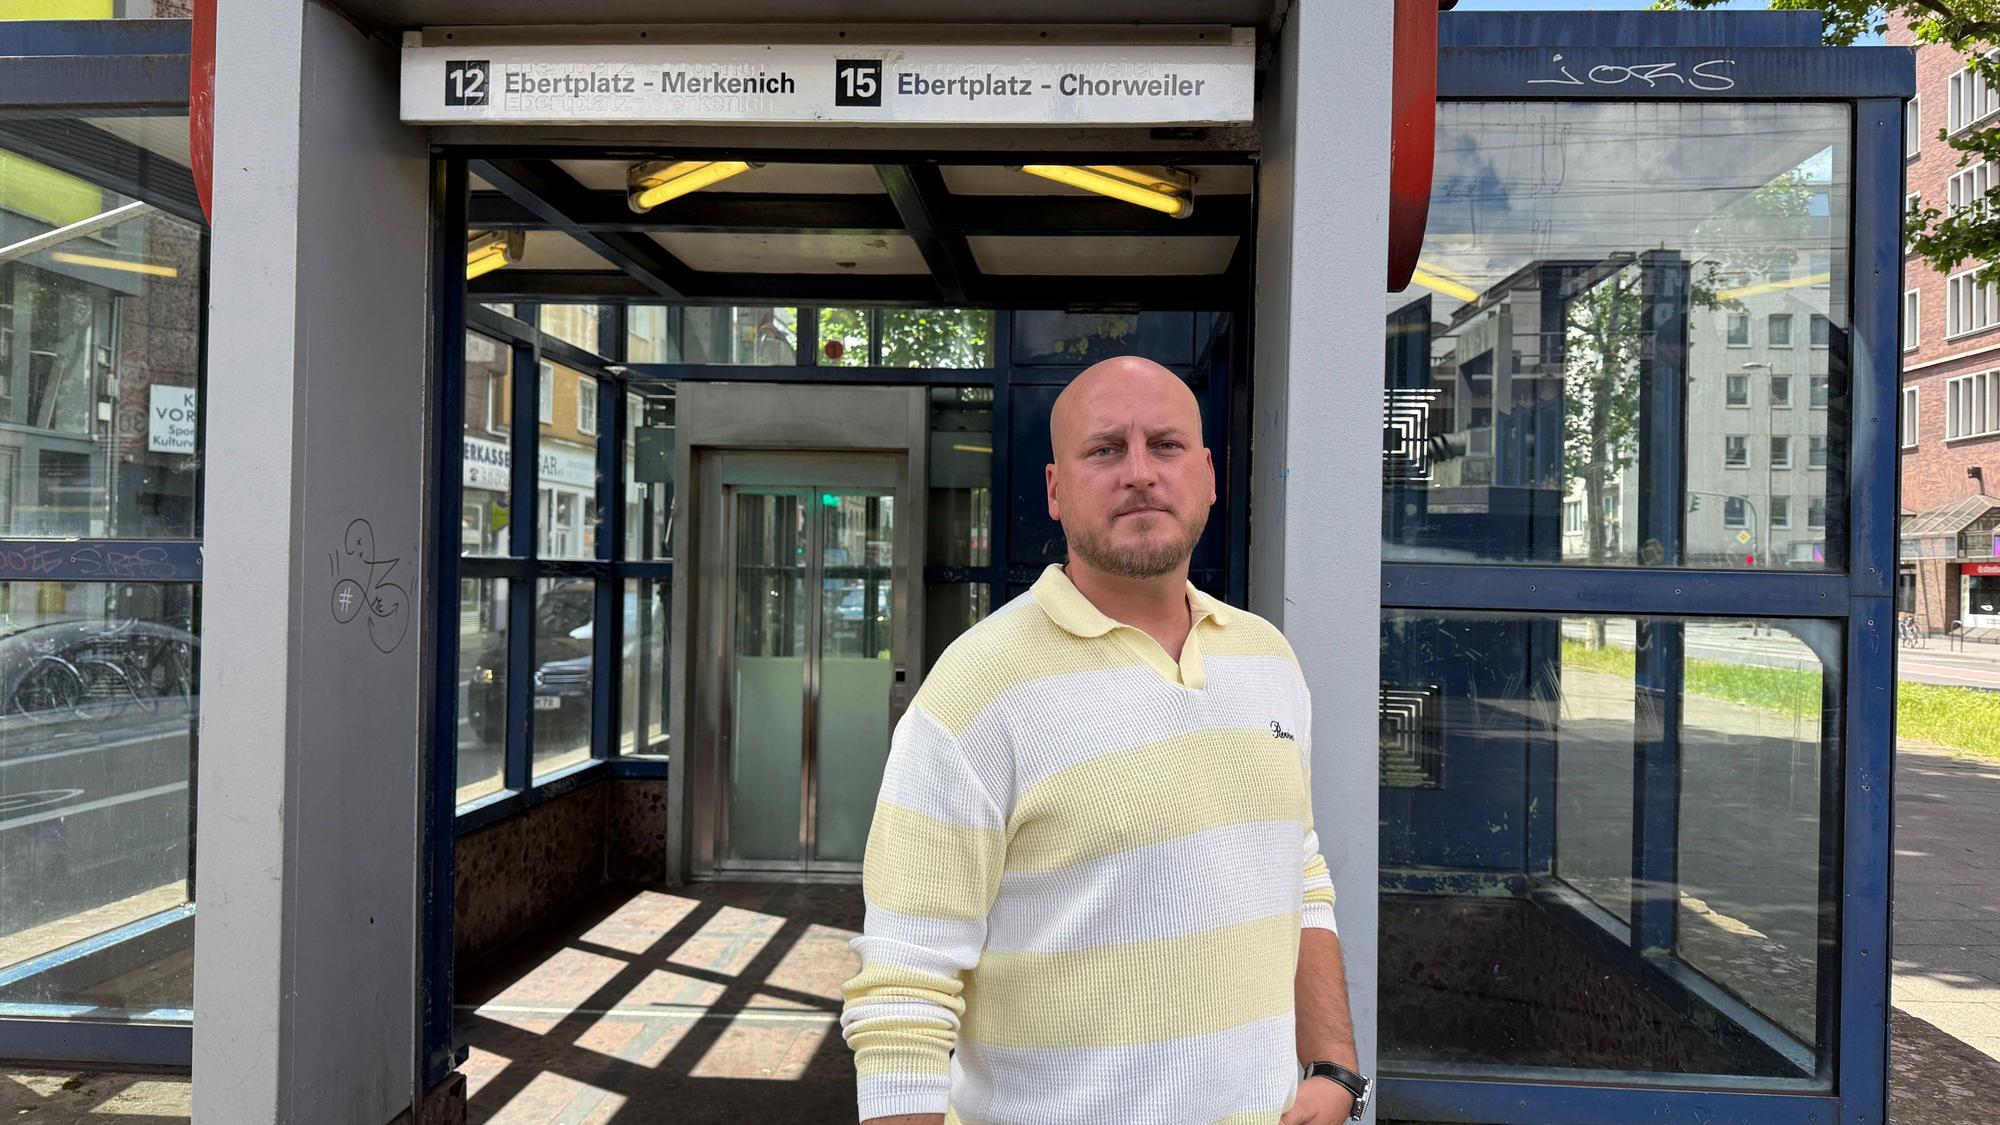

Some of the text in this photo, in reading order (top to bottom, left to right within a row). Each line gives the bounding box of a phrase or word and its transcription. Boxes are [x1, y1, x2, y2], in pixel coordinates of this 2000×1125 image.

[449, 68, 485, 98] 12
[505, 72, 635, 98] Ebertplatz
[661, 72, 795, 94] Merkenich
[840, 67, 877, 98] 15
[898, 73, 1032, 100] Ebertplatz
[1059, 73, 1206, 96] Chorweiler
